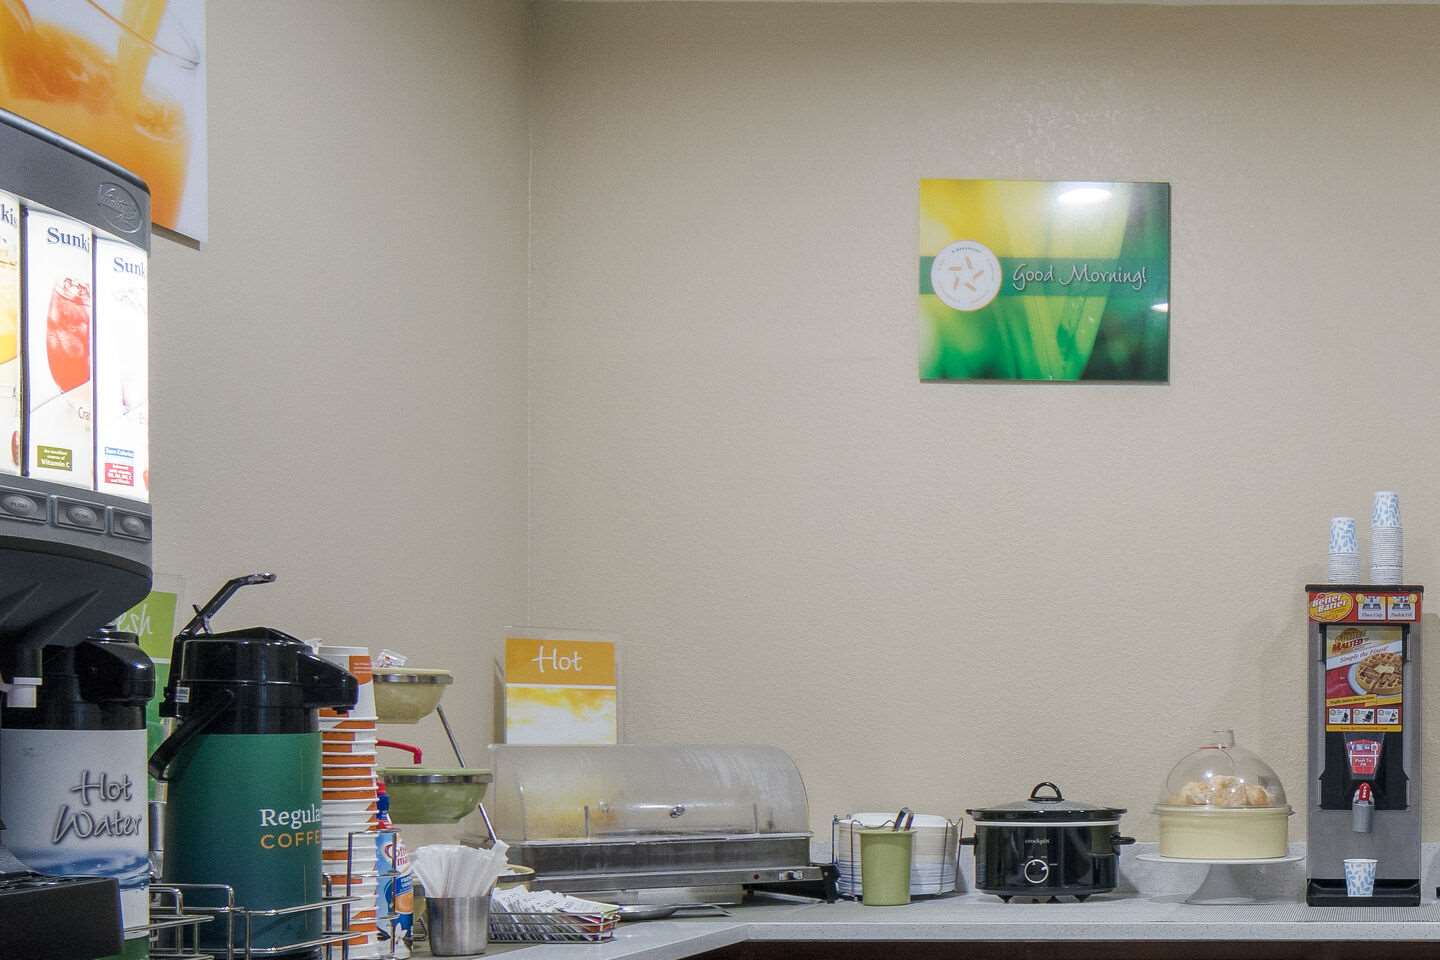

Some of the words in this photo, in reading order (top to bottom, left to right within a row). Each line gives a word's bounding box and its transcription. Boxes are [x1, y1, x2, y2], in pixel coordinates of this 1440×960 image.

[1012, 263, 1054, 291] Good
[1058, 264, 1148, 290] Morning!
[531, 645, 583, 673] Hot
[72, 769, 133, 806] Hot
[51, 804, 143, 846] Water
[260, 803, 322, 830] Regula
[260, 831, 322, 850] COFFE
